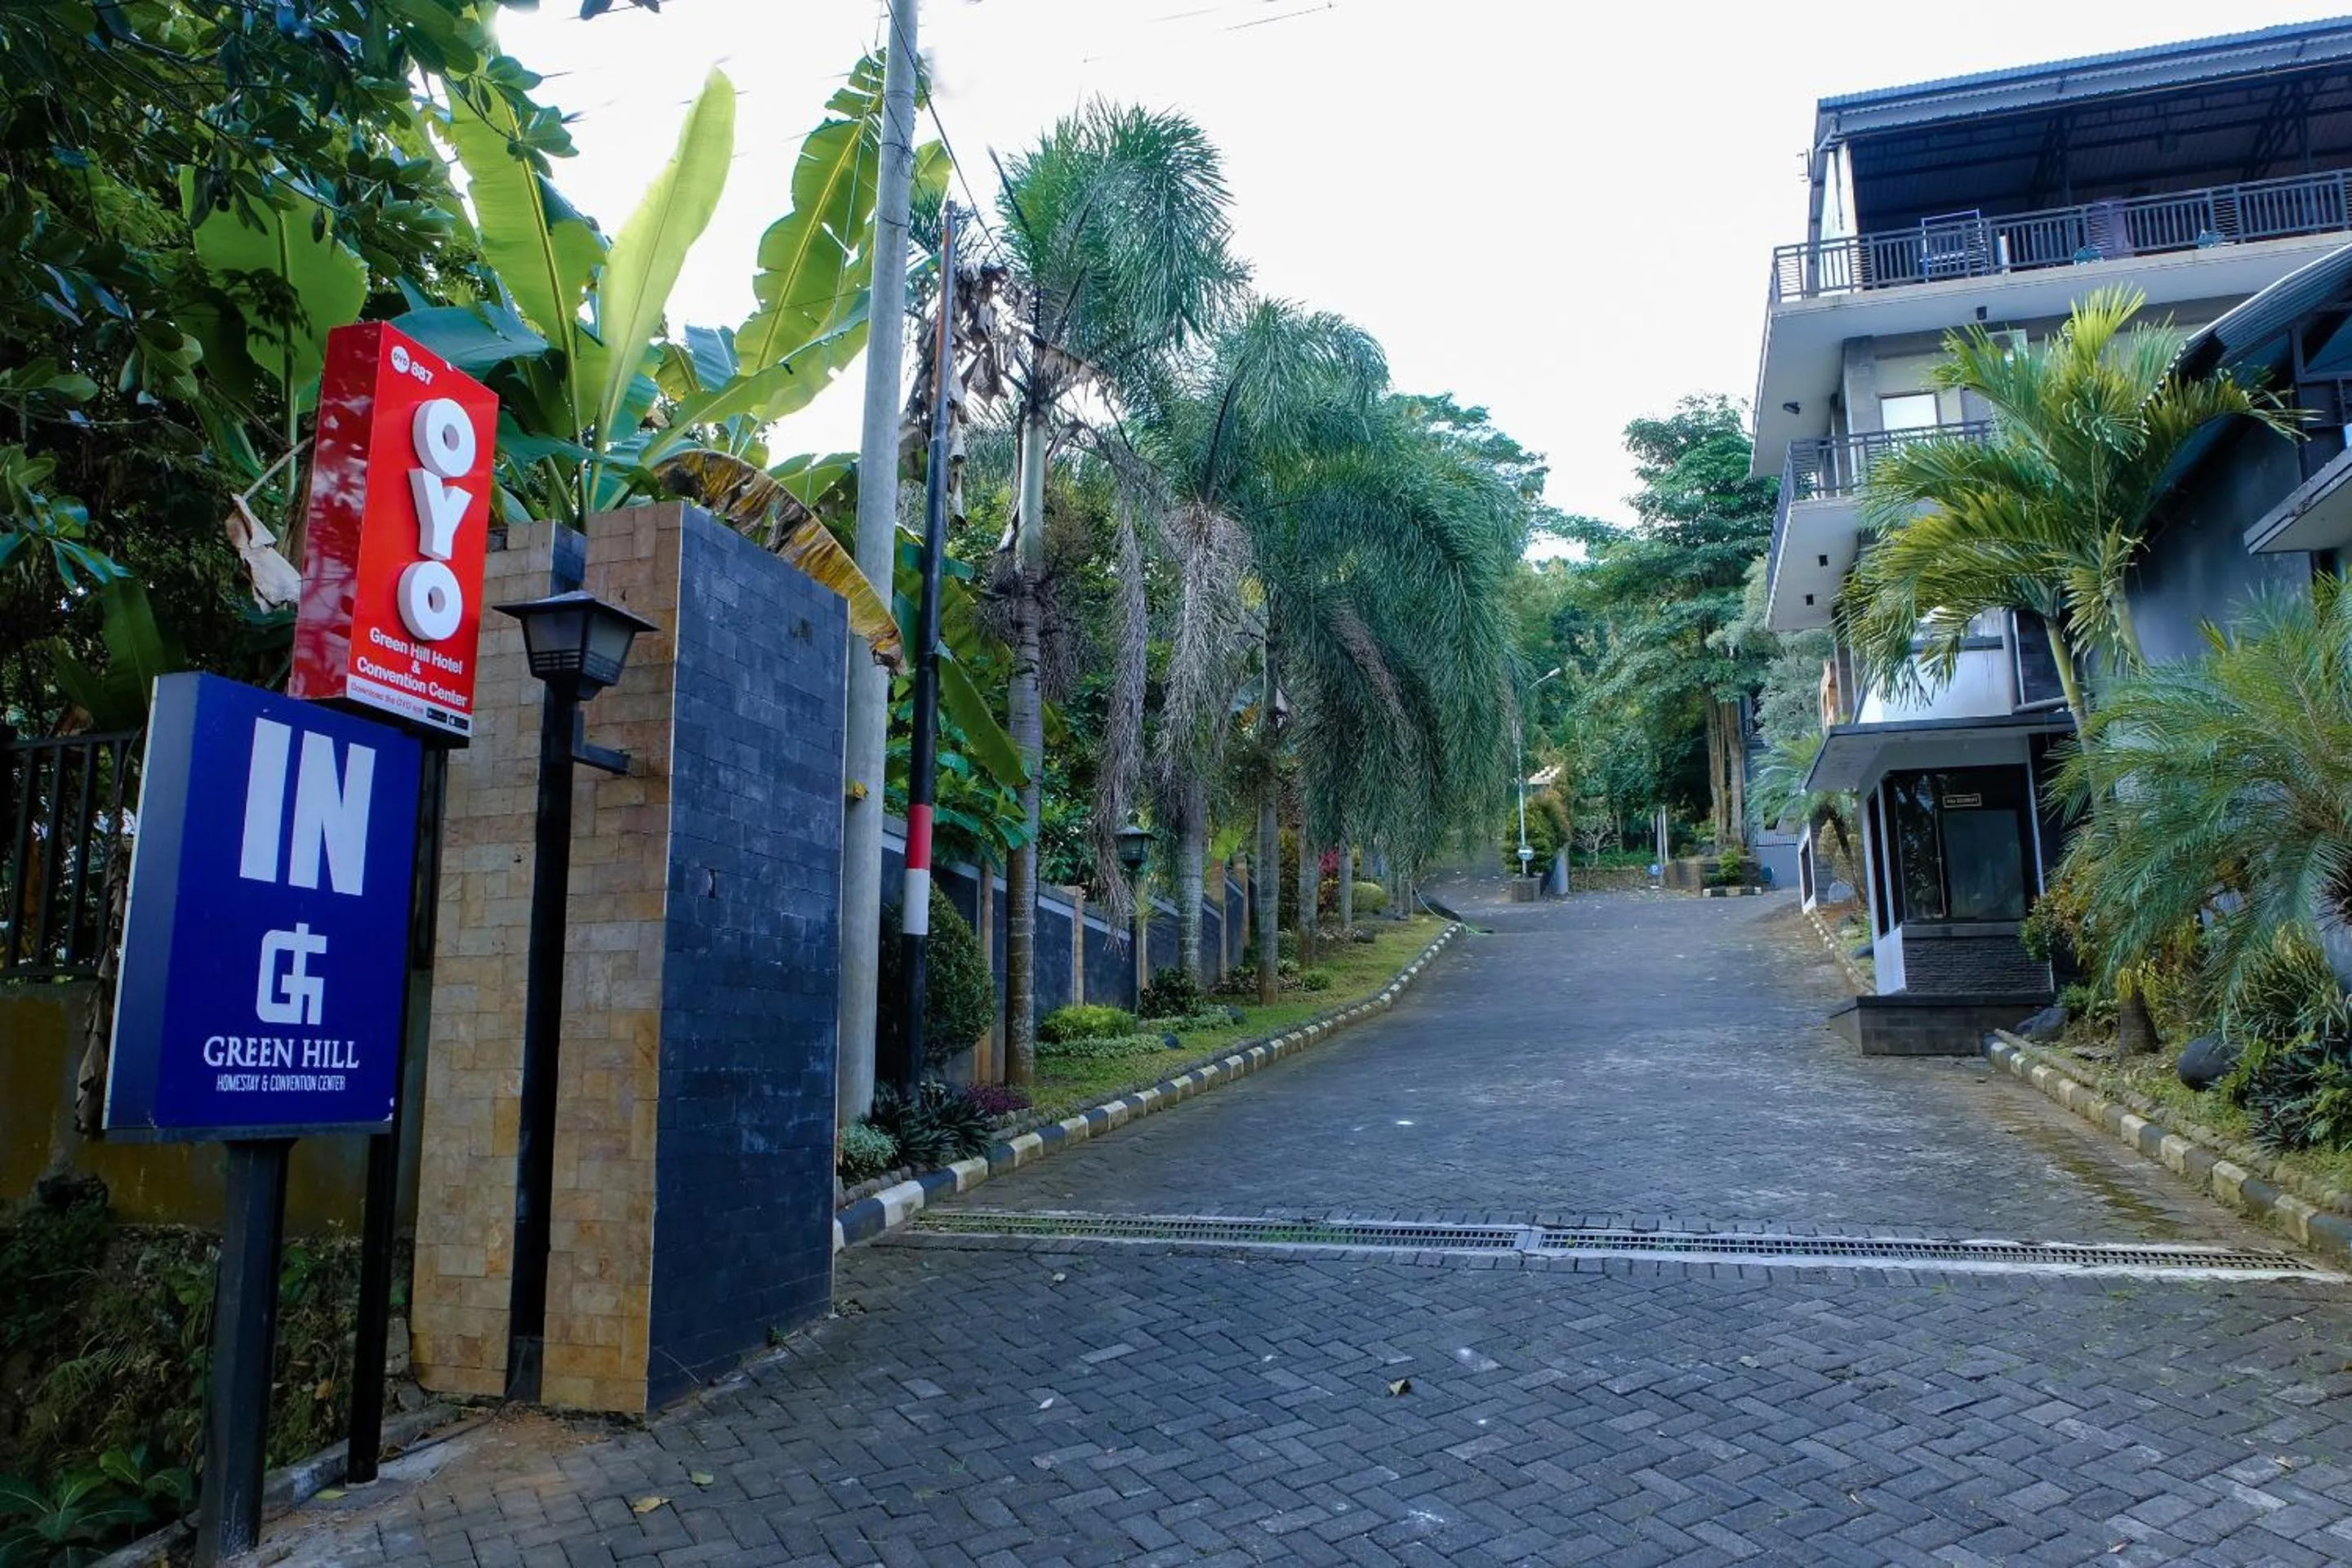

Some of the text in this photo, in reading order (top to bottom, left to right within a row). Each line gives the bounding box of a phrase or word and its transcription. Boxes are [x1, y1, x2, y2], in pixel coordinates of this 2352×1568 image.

[393, 351, 408, 367] OYO
[397, 398, 475, 640] OYO
[369, 626, 463, 675] Green Hill Hotel
[412, 660, 421, 675] &
[357, 656, 468, 707] Convention Center
[239, 717, 376, 896] IN
[203, 1036, 360, 1069] GREEN HILL
[216, 1074, 346, 1092] HOMESTAY & CONVENTION CENTER
